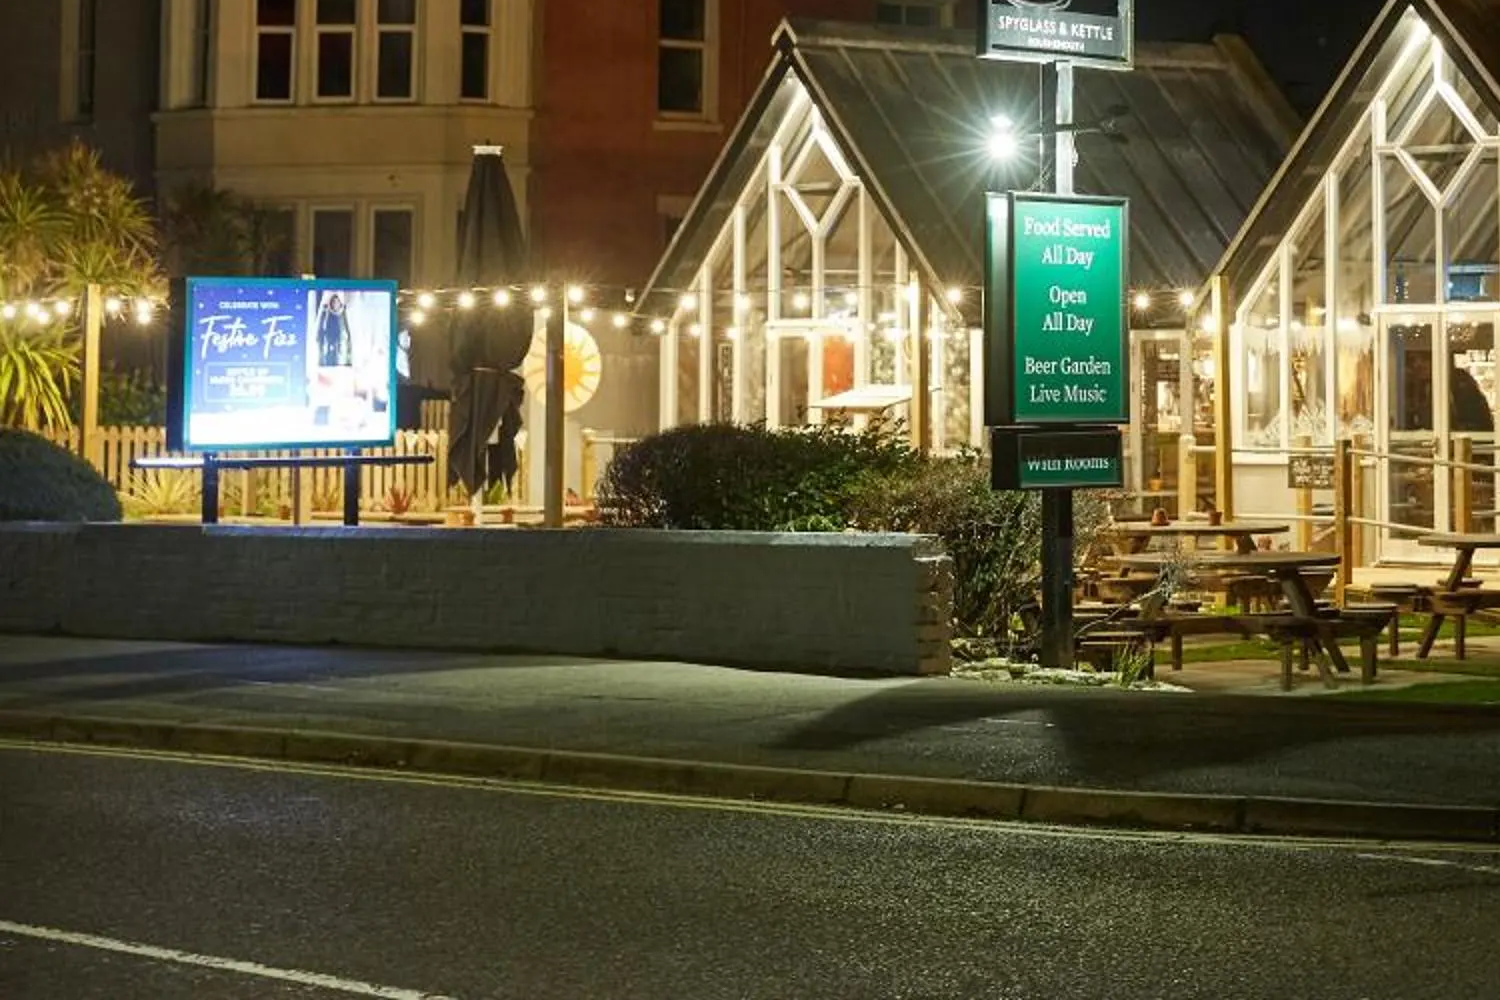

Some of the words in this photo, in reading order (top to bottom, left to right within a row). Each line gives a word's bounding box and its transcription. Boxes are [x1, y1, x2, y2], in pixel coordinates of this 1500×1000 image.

[998, 16, 1056, 35] SPYGLASS
[1071, 23, 1113, 40] KETTLE
[1023, 216, 1060, 236] Food
[1063, 217, 1111, 239] Served
[1041, 247, 1062, 265] All
[1066, 248, 1095, 269] Day
[1049, 285, 1087, 309] Open
[1042, 314, 1062, 331] All
[1066, 315, 1095, 336] Day
[1024, 356, 1058, 375] Beer
[1061, 357, 1111, 376] Garden
[1029, 384, 1061, 403] Live
[1064, 385, 1108, 404] Music
